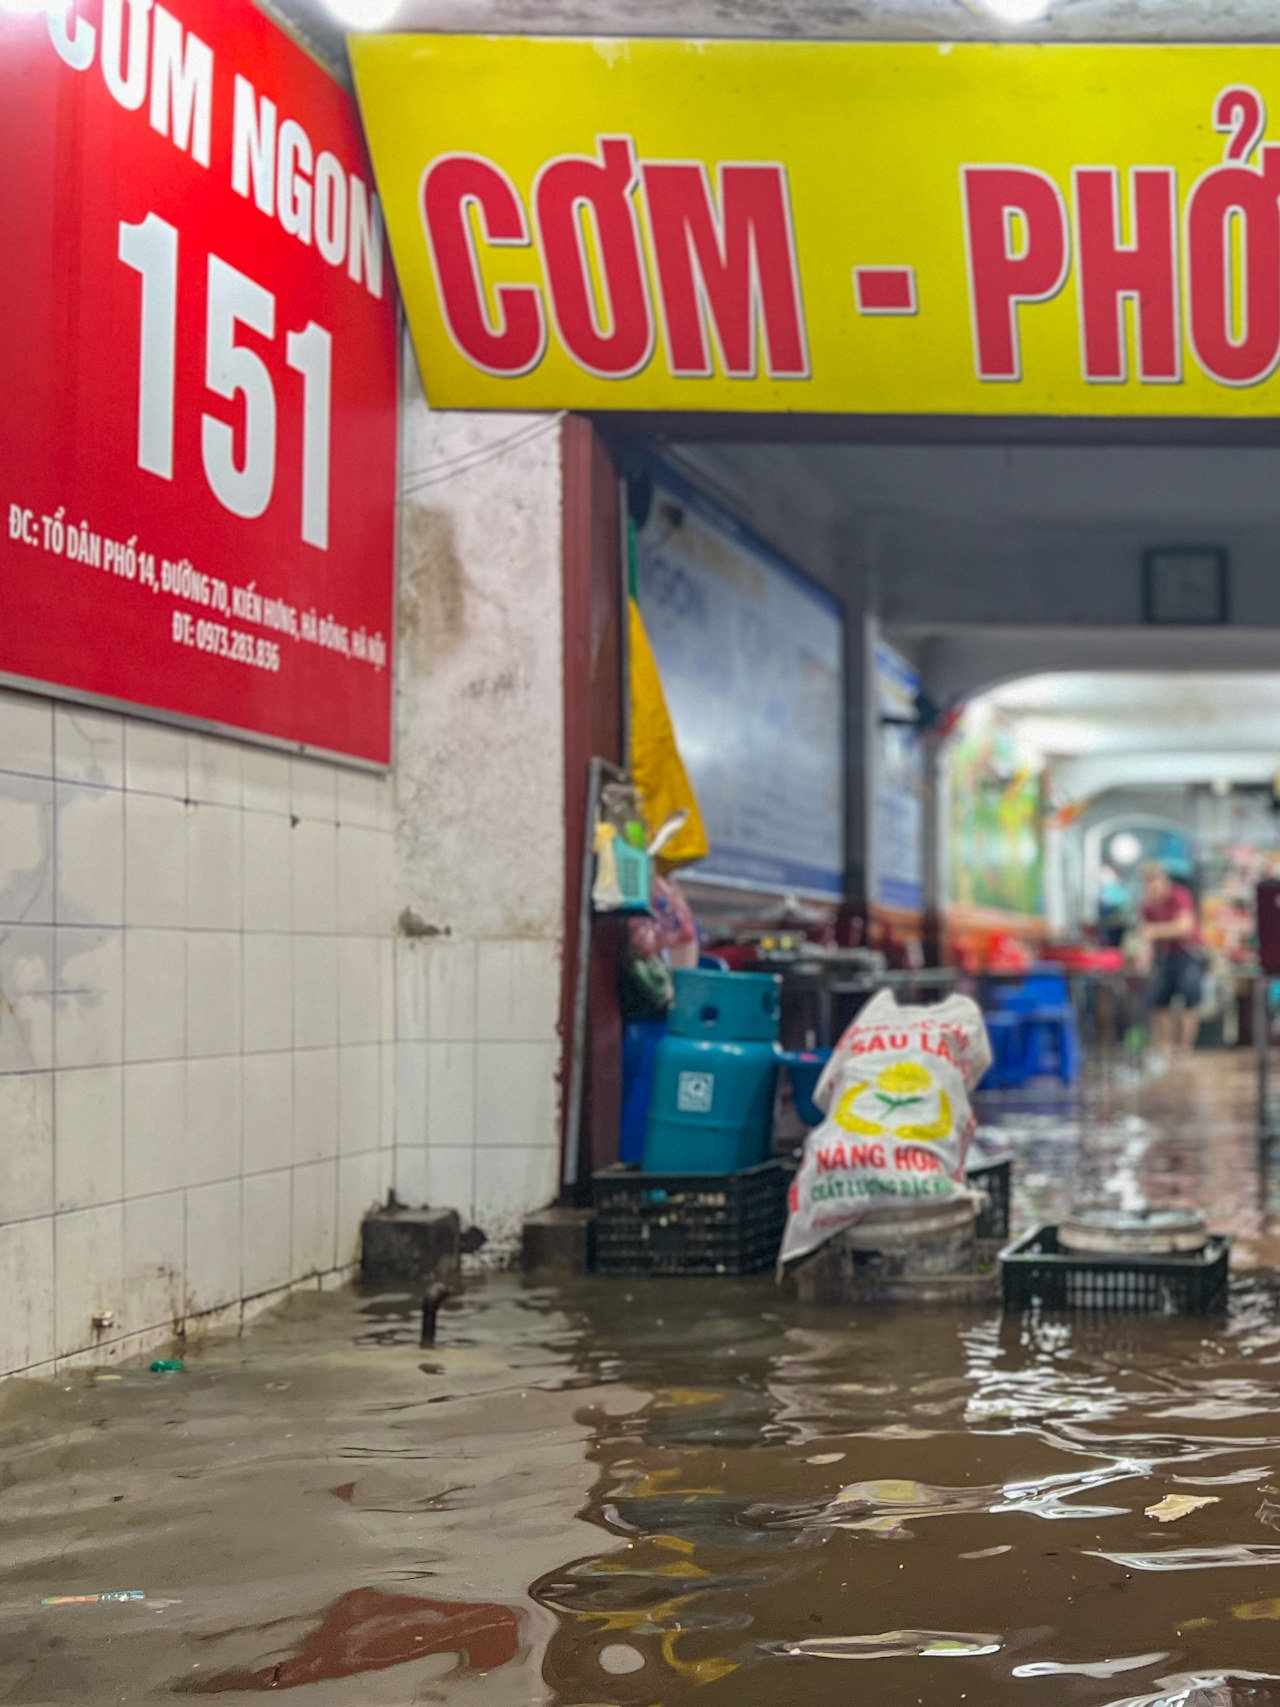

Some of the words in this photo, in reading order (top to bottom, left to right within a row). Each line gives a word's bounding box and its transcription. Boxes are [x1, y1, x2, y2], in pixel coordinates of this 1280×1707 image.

[231, 73, 384, 300] NGON
[419, 133, 812, 379] CƠM
[118, 211, 333, 552] 151
[9, 503, 39, 547] ĐC:
[42, 506, 65, 555] TỔ
[66, 520, 101, 569] DÂN
[103, 534, 138, 581] PHỐ
[138, 551, 160, 594] 14,
[161, 558, 210, 606] ĐƯỜNG
[210, 578, 231, 618] 70,
[232, 580, 263, 624] KIẾN
[172, 609, 195, 648] ĐT:
[816, 1139, 887, 1174] NÀNG
